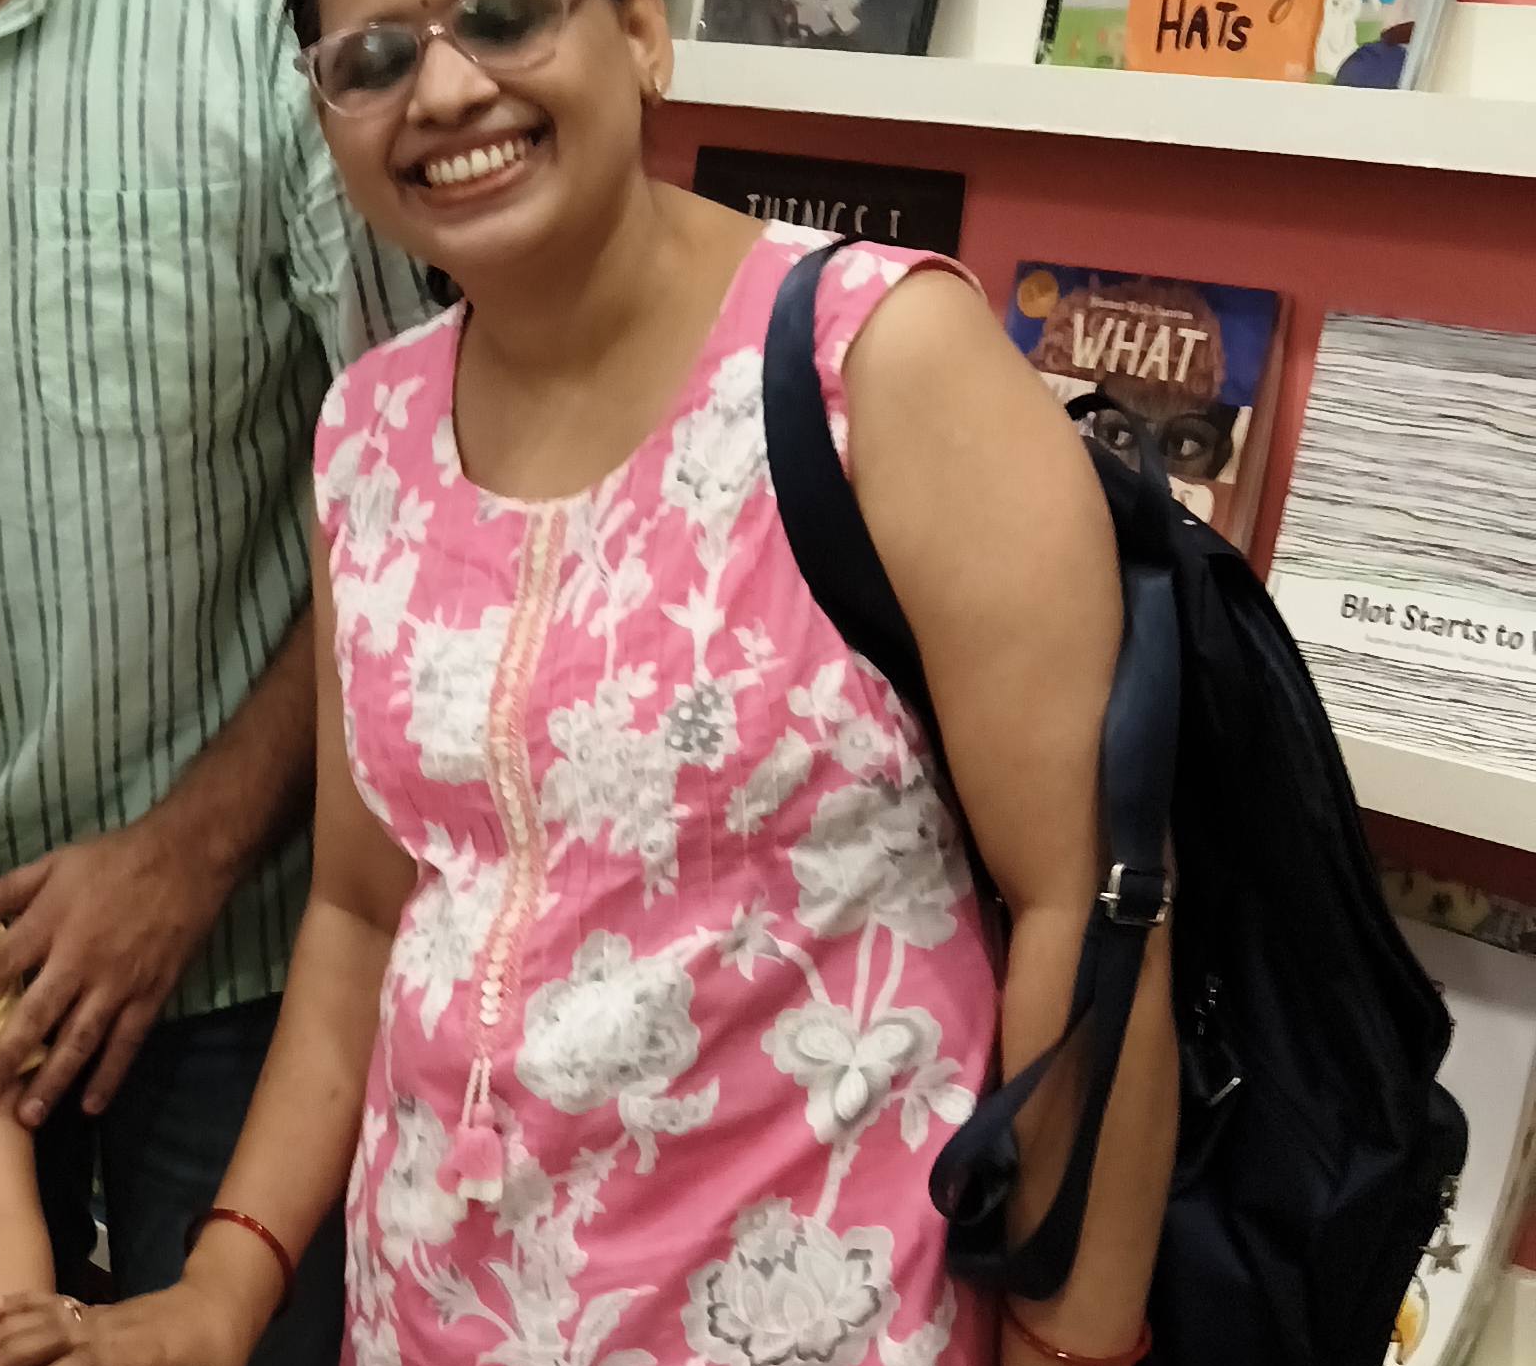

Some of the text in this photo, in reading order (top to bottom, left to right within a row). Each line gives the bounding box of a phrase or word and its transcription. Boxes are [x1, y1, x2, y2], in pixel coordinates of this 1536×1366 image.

[1072, 312, 1209, 383] WHAT
[1340, 593, 1395, 625] Blot
[1400, 604, 1489, 645] Starts
[1495, 624, 1525, 650] to
